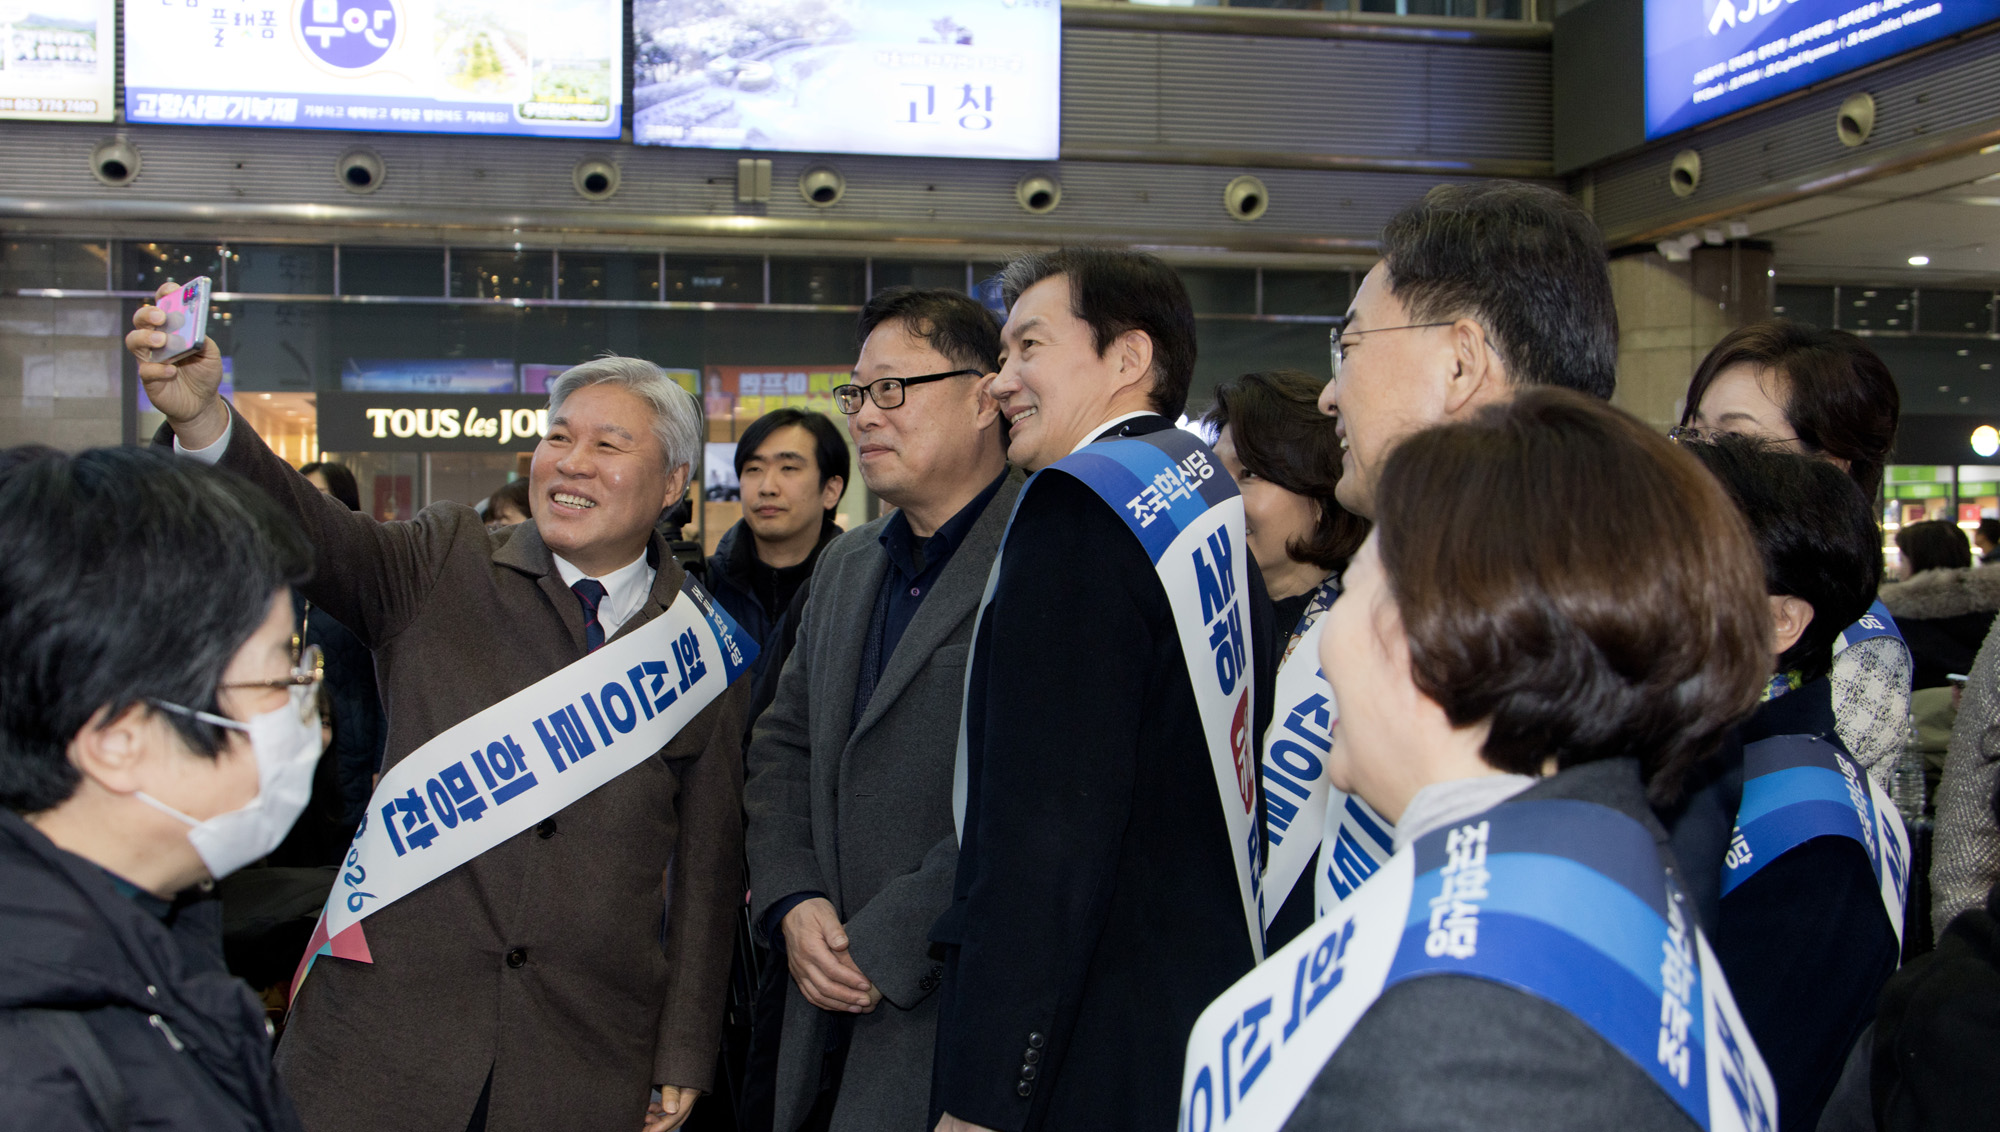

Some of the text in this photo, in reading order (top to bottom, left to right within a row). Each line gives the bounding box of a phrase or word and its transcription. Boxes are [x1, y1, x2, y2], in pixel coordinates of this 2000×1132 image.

[209, 8, 279, 48] 플랫폼
[133, 93, 298, 122] 고향사랑기부제
[894, 82, 998, 131] 고창
[366, 408, 461, 438] TOUS
[464, 407, 498, 437] les
[1126, 449, 1215, 528] 조국혁신당
[691, 584, 744, 669] 조국혁신당
[1192, 524, 1247, 697] 새해
[381, 626, 708, 858] 혁신으로 희망찬
[1425, 820, 1490, 959] 조국혁신당
